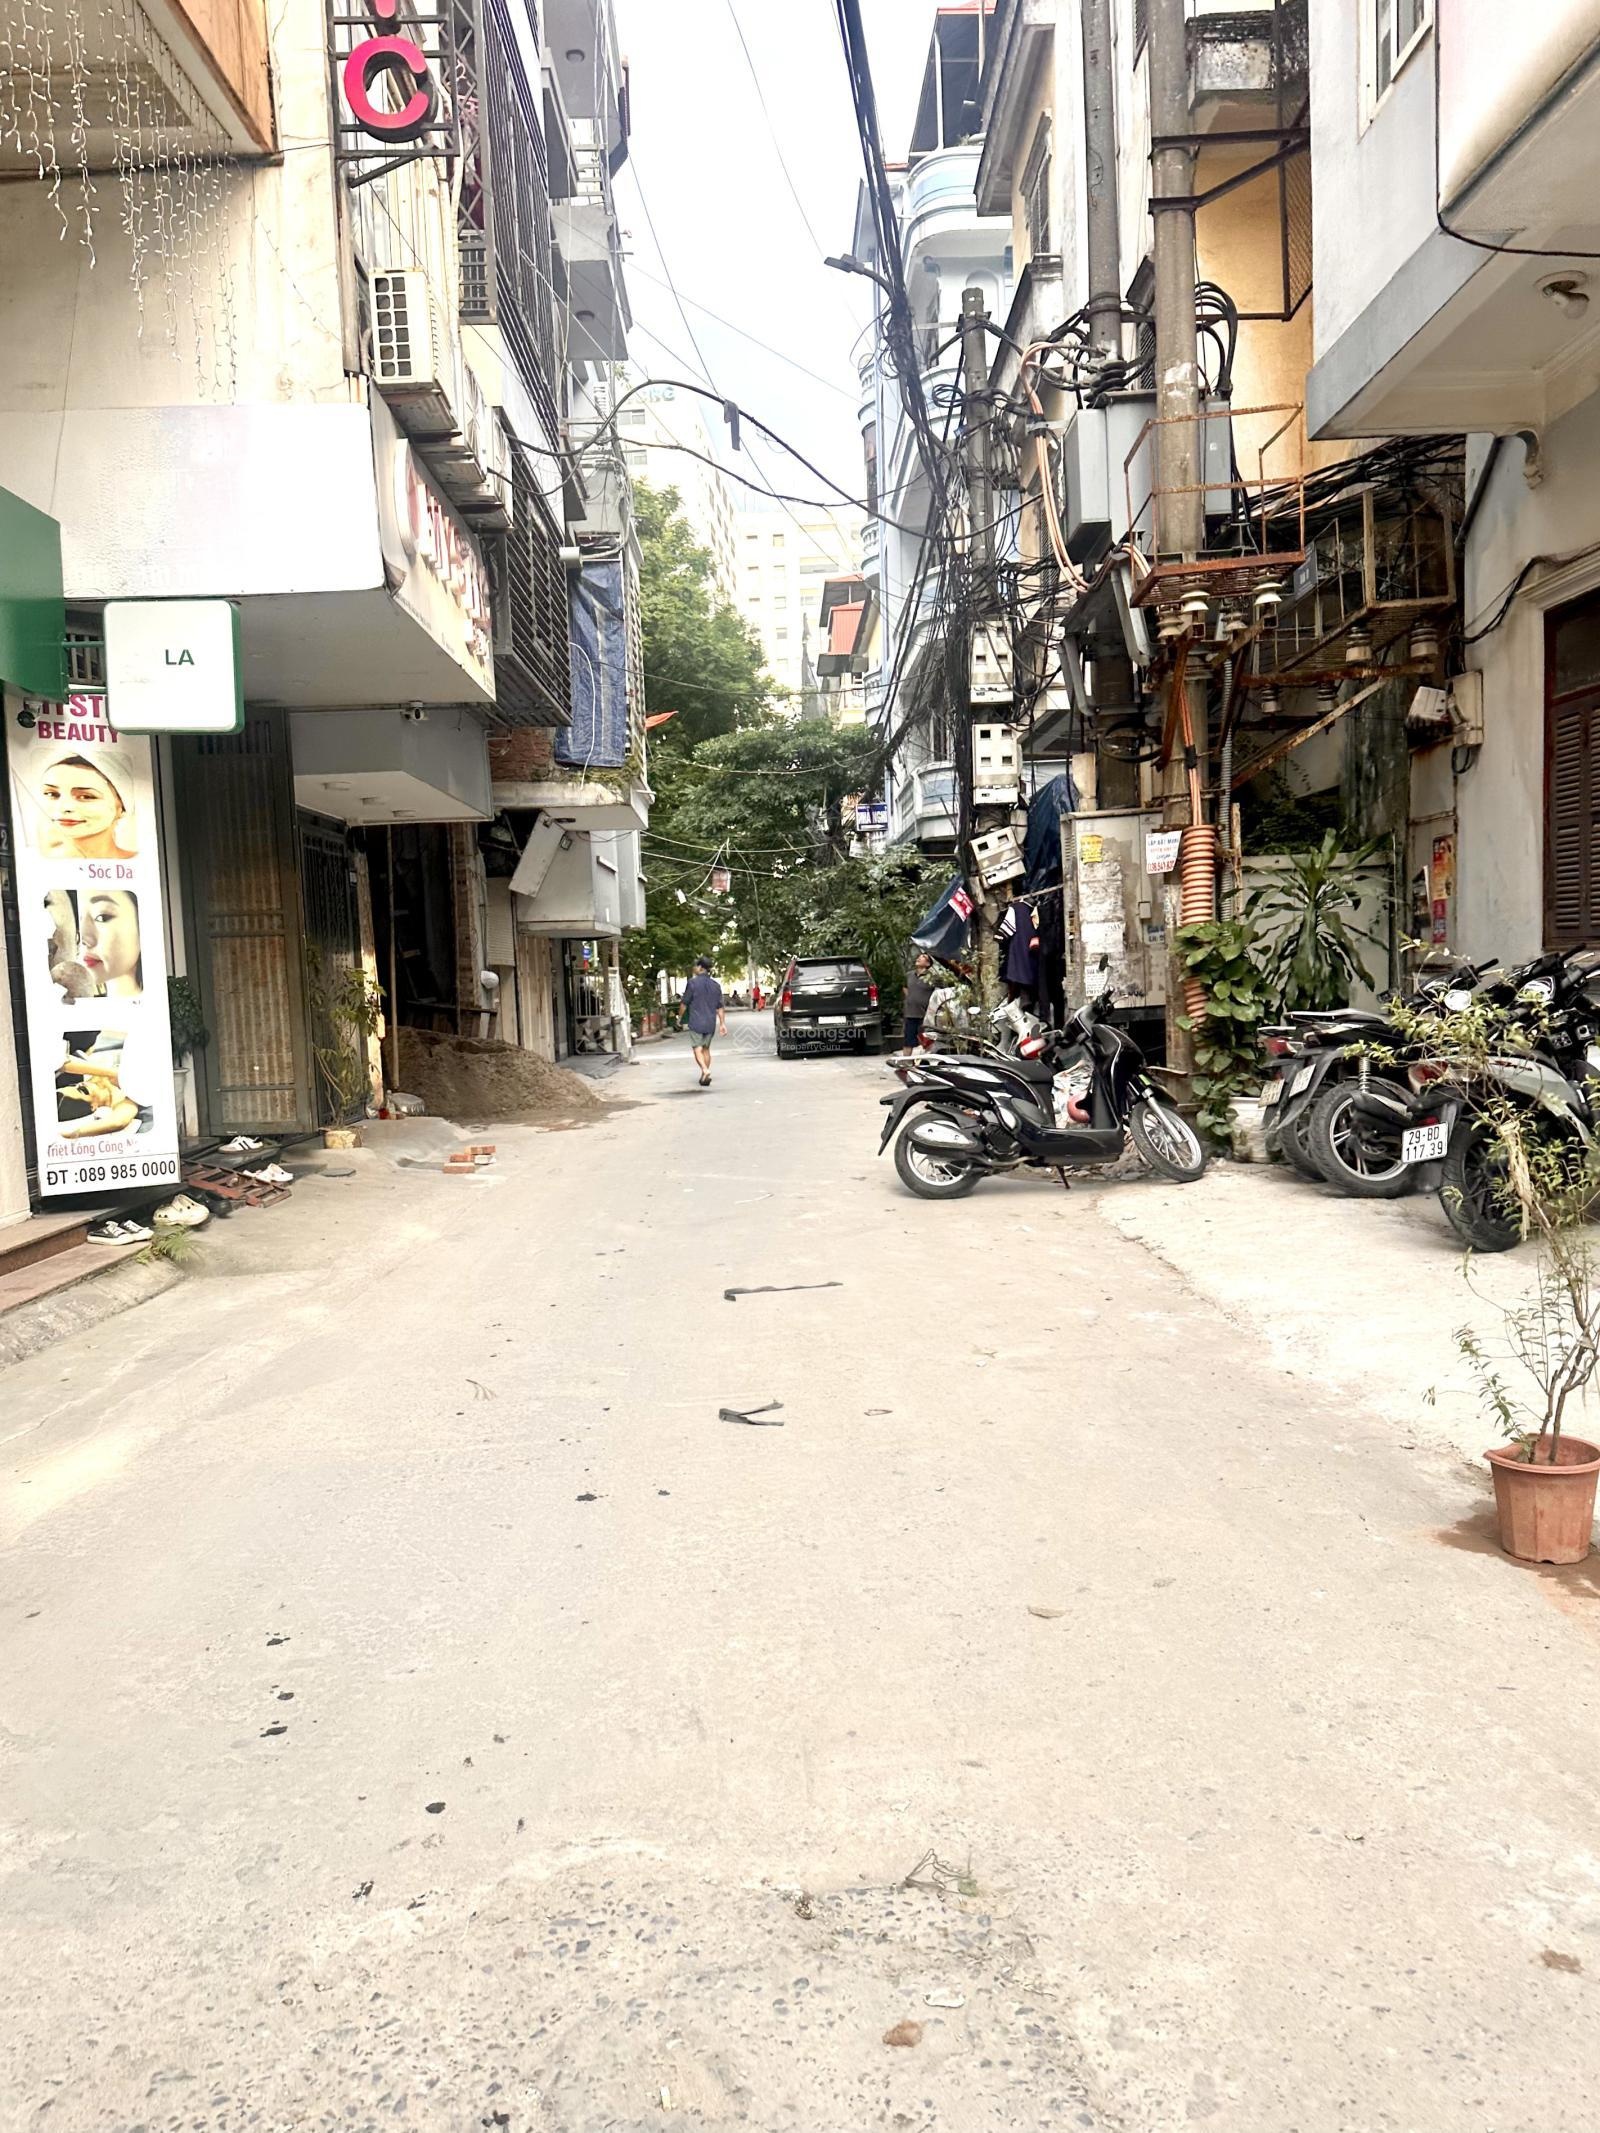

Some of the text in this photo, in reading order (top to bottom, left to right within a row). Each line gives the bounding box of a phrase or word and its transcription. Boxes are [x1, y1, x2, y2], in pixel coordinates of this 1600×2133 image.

[165, 649, 194, 665] LA
[38, 721, 118, 743] BEAUTY
[116, 864, 133, 879] Da
[1406, 1141, 1443, 1161] 117.39
[46, 1169, 68, 1186] ĐT
[111, 1163, 137, 1181] 985
[142, 1160, 176, 1177] 0000
